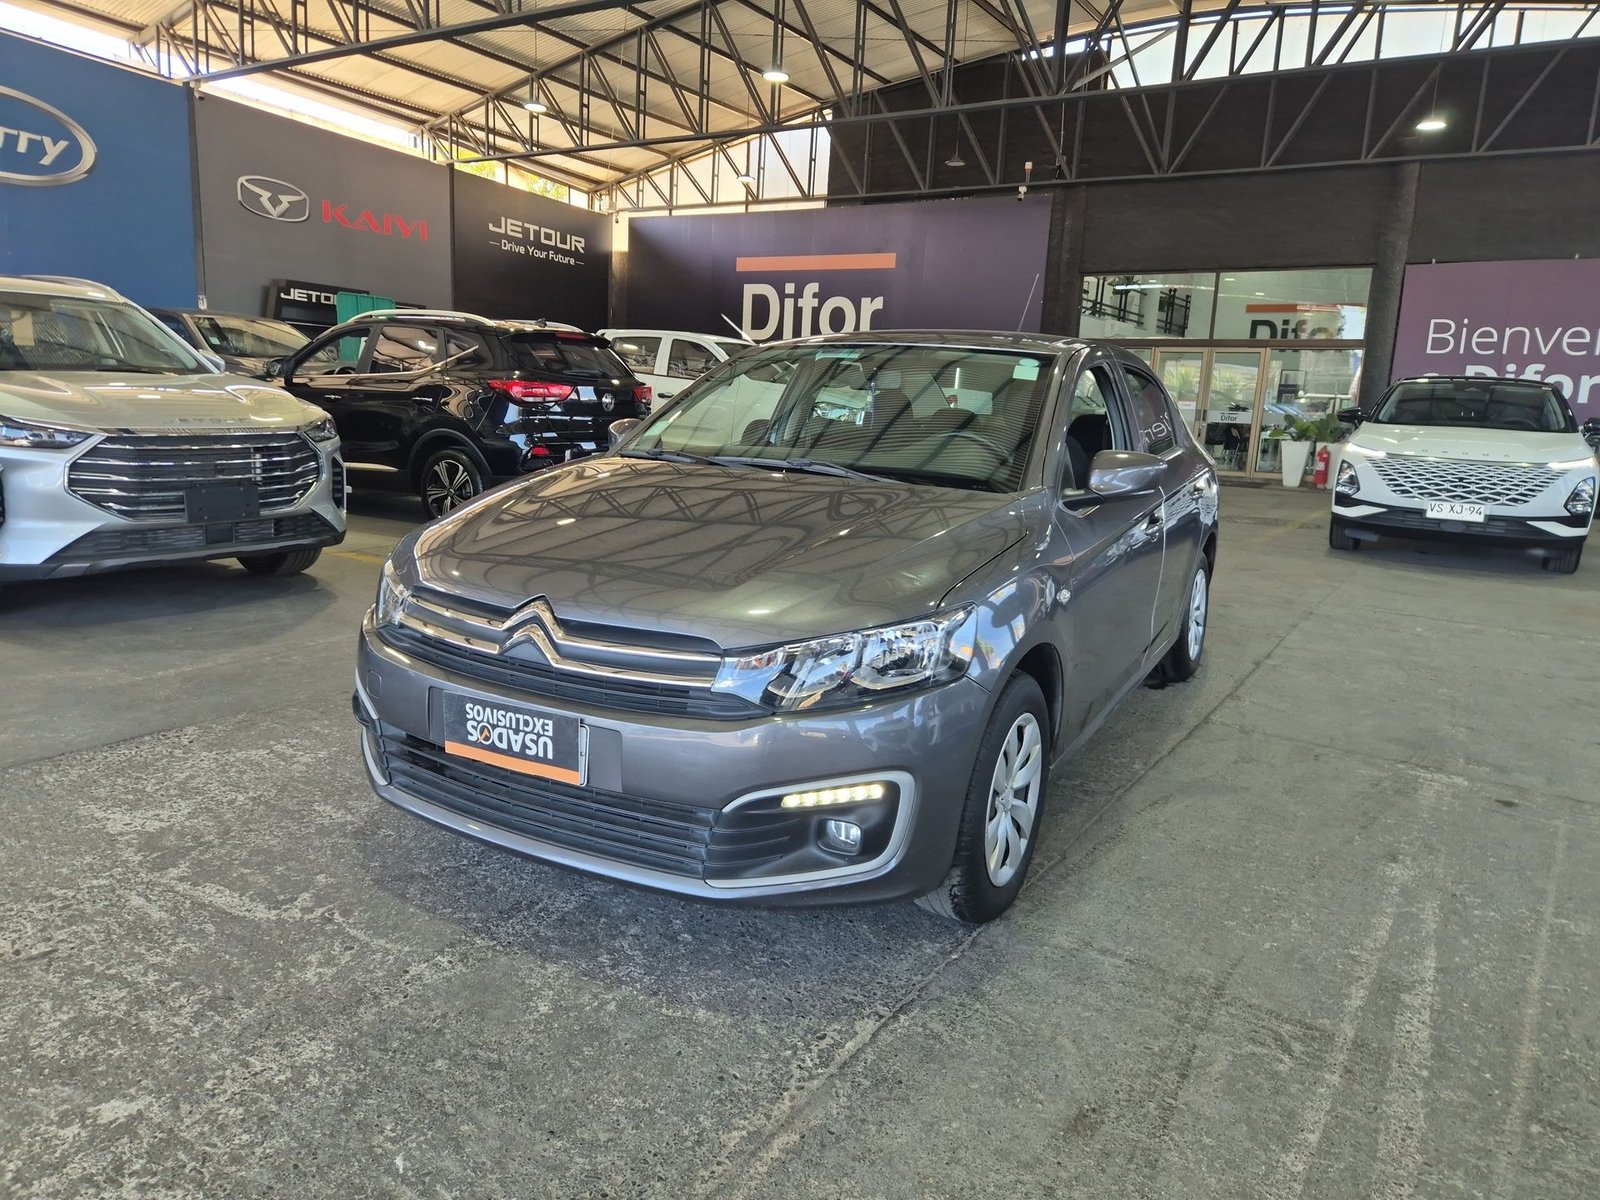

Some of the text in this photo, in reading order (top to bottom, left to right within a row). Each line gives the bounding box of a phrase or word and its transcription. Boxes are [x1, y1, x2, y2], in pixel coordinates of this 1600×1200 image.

[488, 216, 585, 254] JETOUR
[501, 239, 575, 265] Drive Your Future
[280, 288, 337, 305] JETO
[741, 282, 884, 341] Difor
[1220, 414, 1238, 422] Difor
[465, 703, 553, 737] EXCLUSIVOS
[466, 720, 553, 760] USADOS
